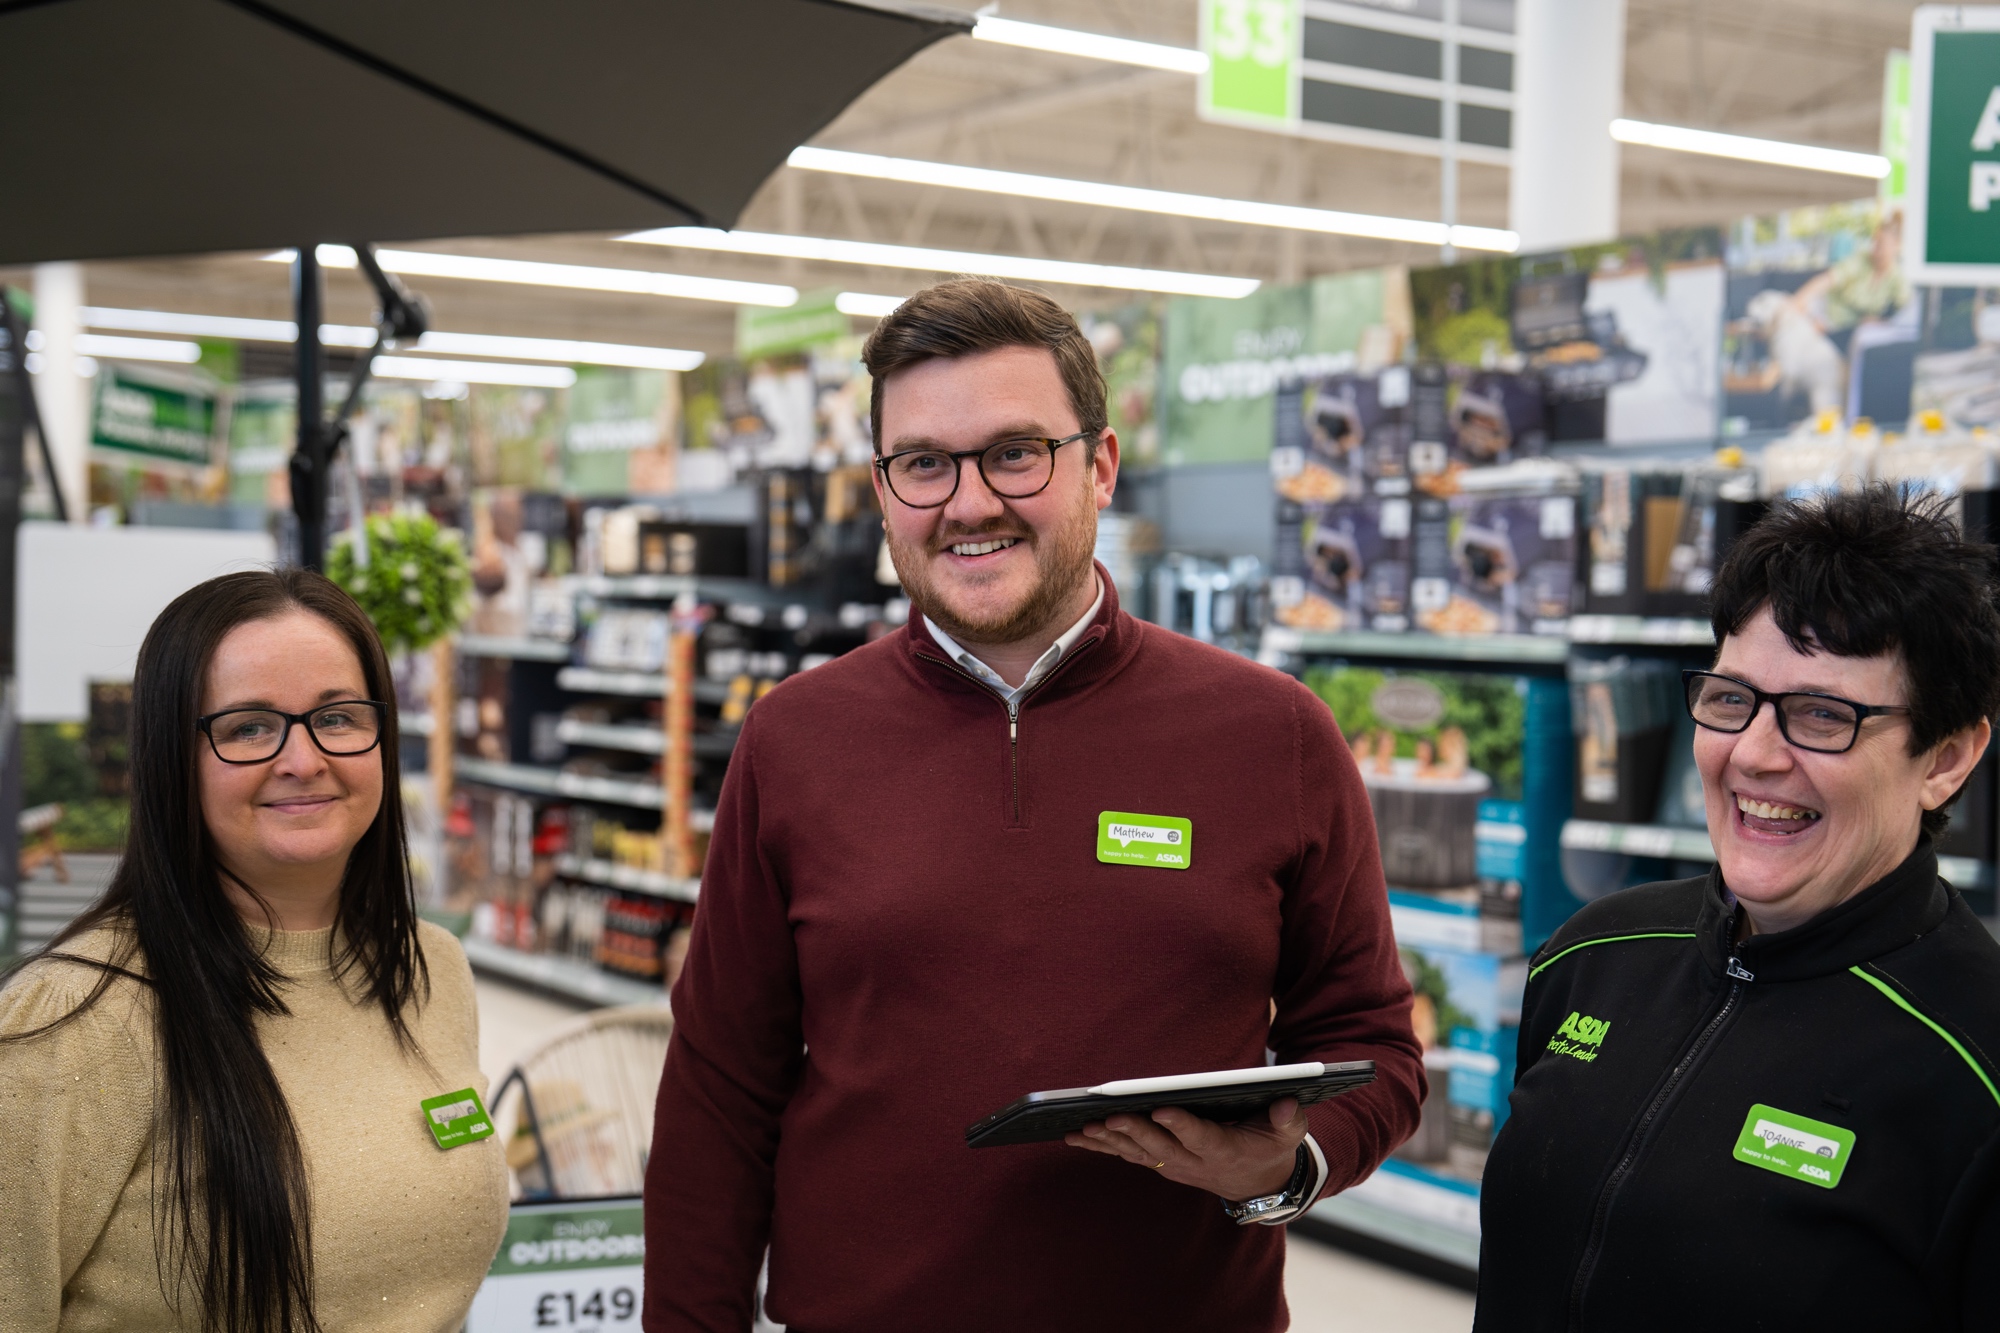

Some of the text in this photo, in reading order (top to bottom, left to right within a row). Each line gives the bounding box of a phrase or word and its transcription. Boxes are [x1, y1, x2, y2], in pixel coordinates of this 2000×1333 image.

[1214, 0, 1288, 67] 33
[1113, 826, 1154, 839] Matthew
[1156, 853, 1184, 864] ASDA
[1557, 1011, 1611, 1047] ASDA
[469, 1121, 489, 1134] ASDA
[1759, 1129, 1806, 1149] JOANNE
[1742, 1146, 1762, 1158] happy
[1797, 1163, 1831, 1182] ASDA
[552, 1218, 613, 1238] ENJOY
[509, 1234, 645, 1265] OUTDOOR
[535, 1287, 636, 1327] £149
